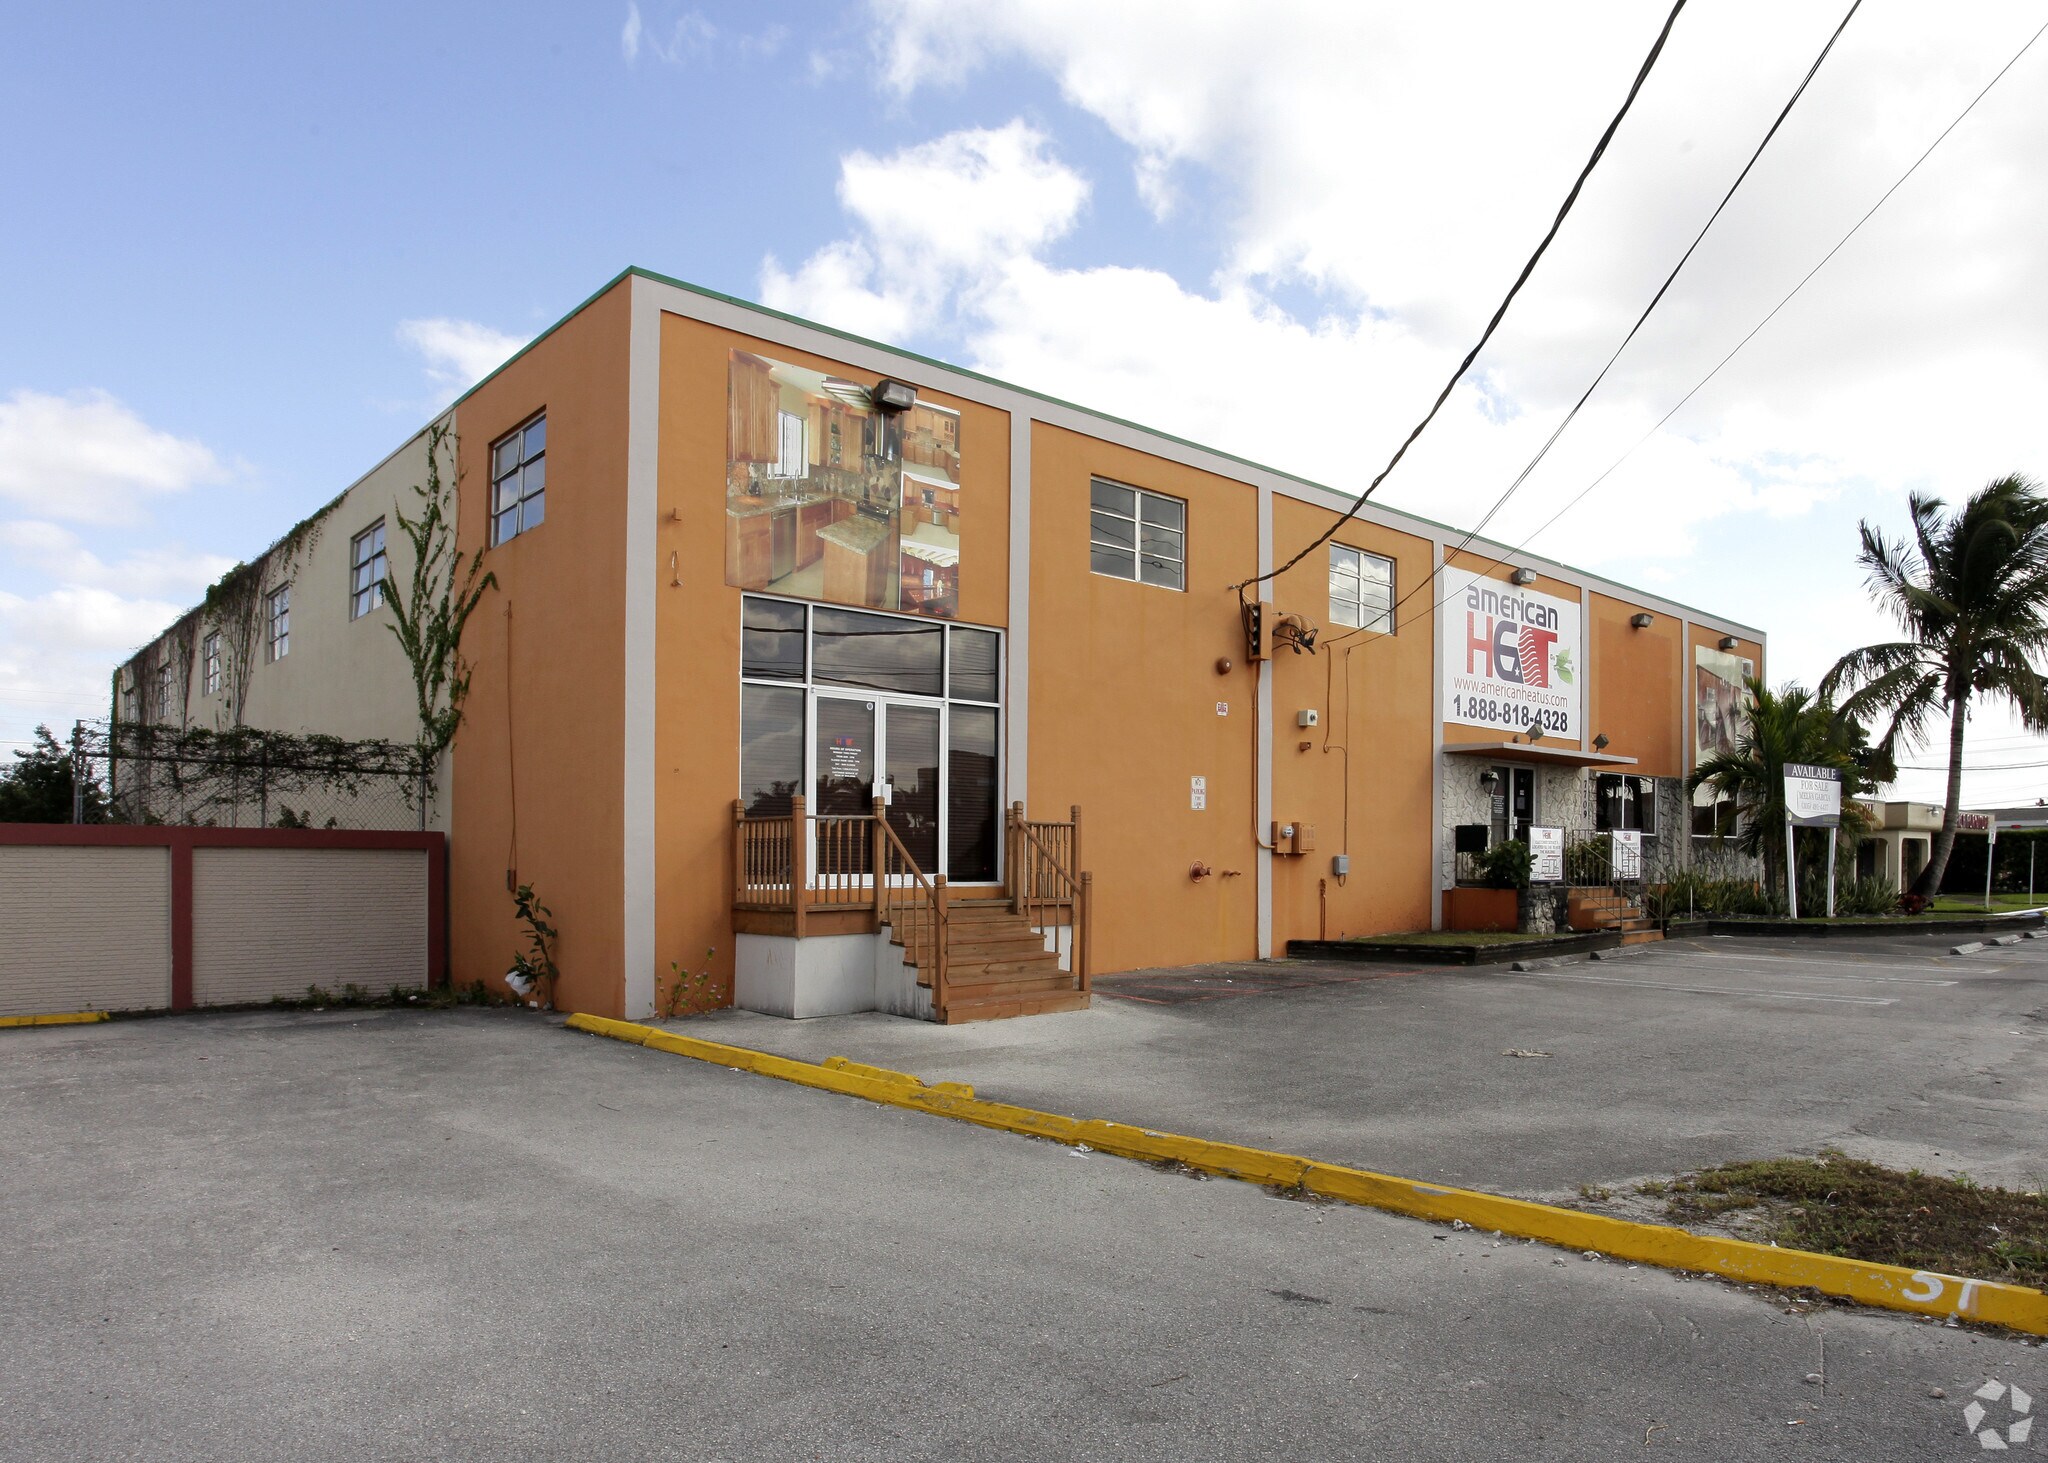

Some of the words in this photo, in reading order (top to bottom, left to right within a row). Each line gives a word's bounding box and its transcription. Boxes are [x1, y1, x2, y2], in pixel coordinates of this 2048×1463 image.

[1466, 584, 1558, 631] american
[1453, 676, 1568, 708] www.americanheatus.com
[1453, 693, 1568, 732] 1.888-818-4328
[1791, 765, 1836, 780] AVAILABLE
[1800, 779, 1813, 791] FOR
[1813, 781, 1829, 792] SALE
